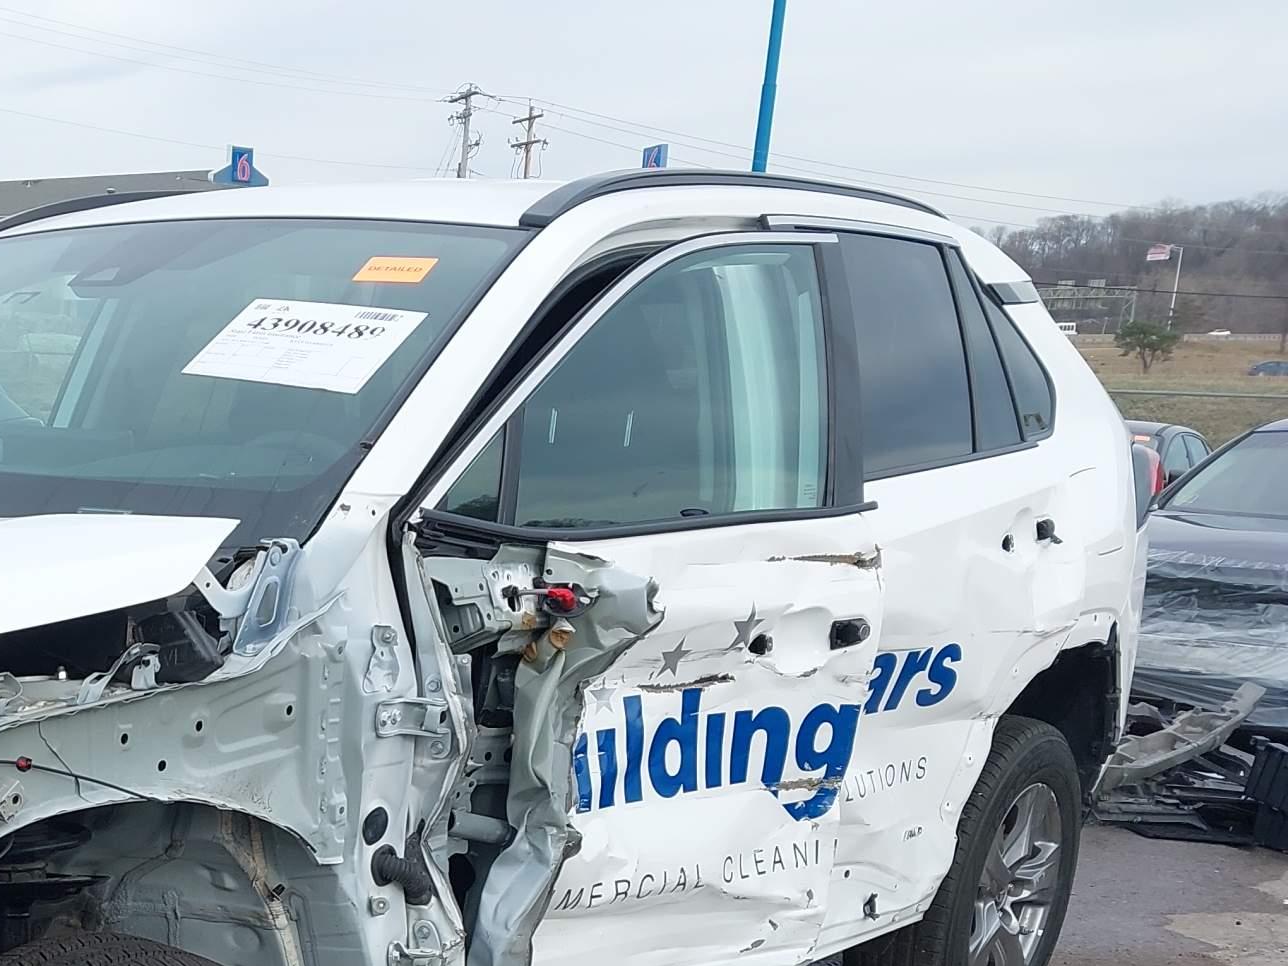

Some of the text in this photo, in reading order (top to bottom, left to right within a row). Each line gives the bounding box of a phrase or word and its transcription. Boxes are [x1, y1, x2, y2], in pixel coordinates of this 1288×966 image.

[237, 152, 250, 181] 6
[246, 316, 386, 340] 43908489
[722, 838, 838, 884] CLEANI
